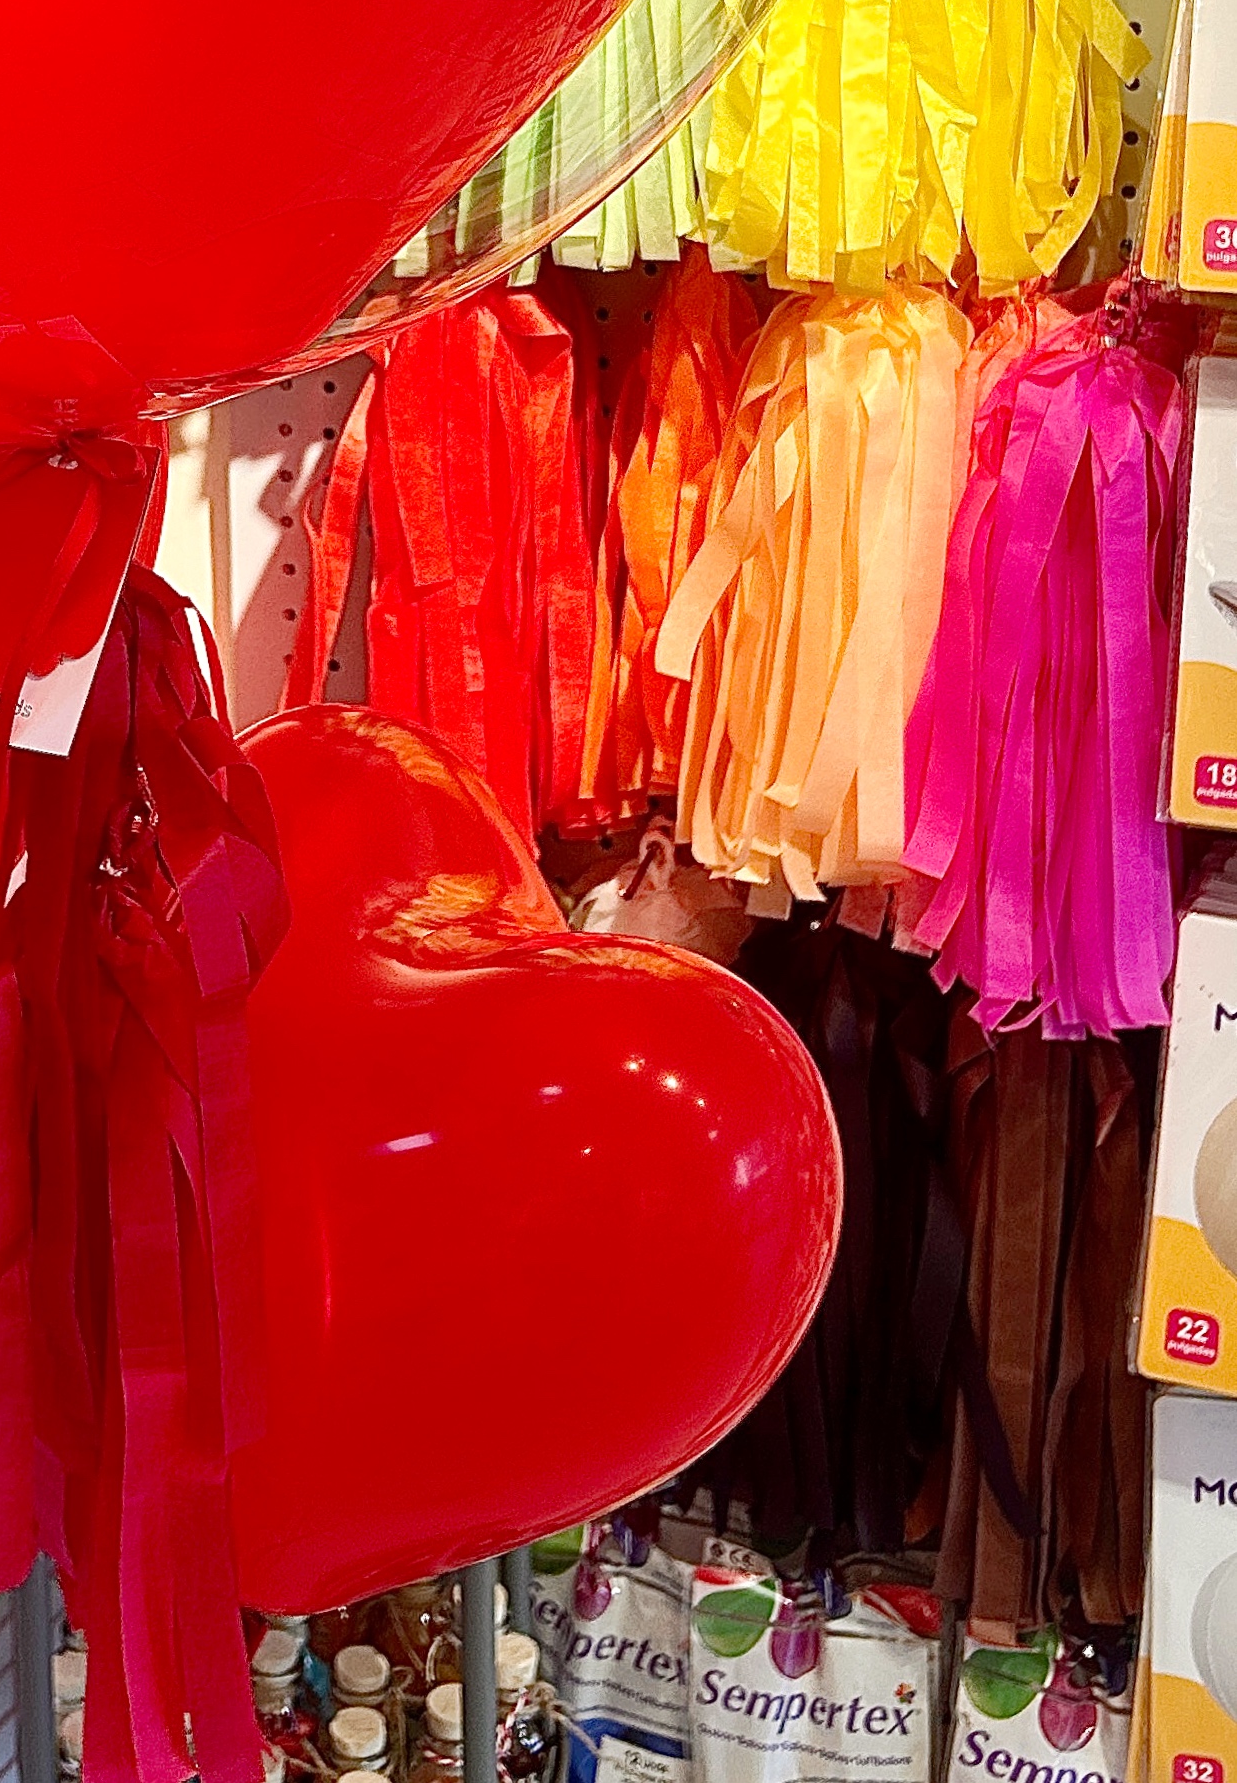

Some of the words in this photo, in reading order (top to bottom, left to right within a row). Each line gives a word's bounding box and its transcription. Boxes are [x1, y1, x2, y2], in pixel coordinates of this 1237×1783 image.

[1206, 762, 1237, 787] 18
[1176, 1316, 1210, 1344] 22
[695, 1669, 915, 1736] Sempertex
[958, 1729, 1124, 1783] Sem
[1183, 1759, 1214, 1783] 32
